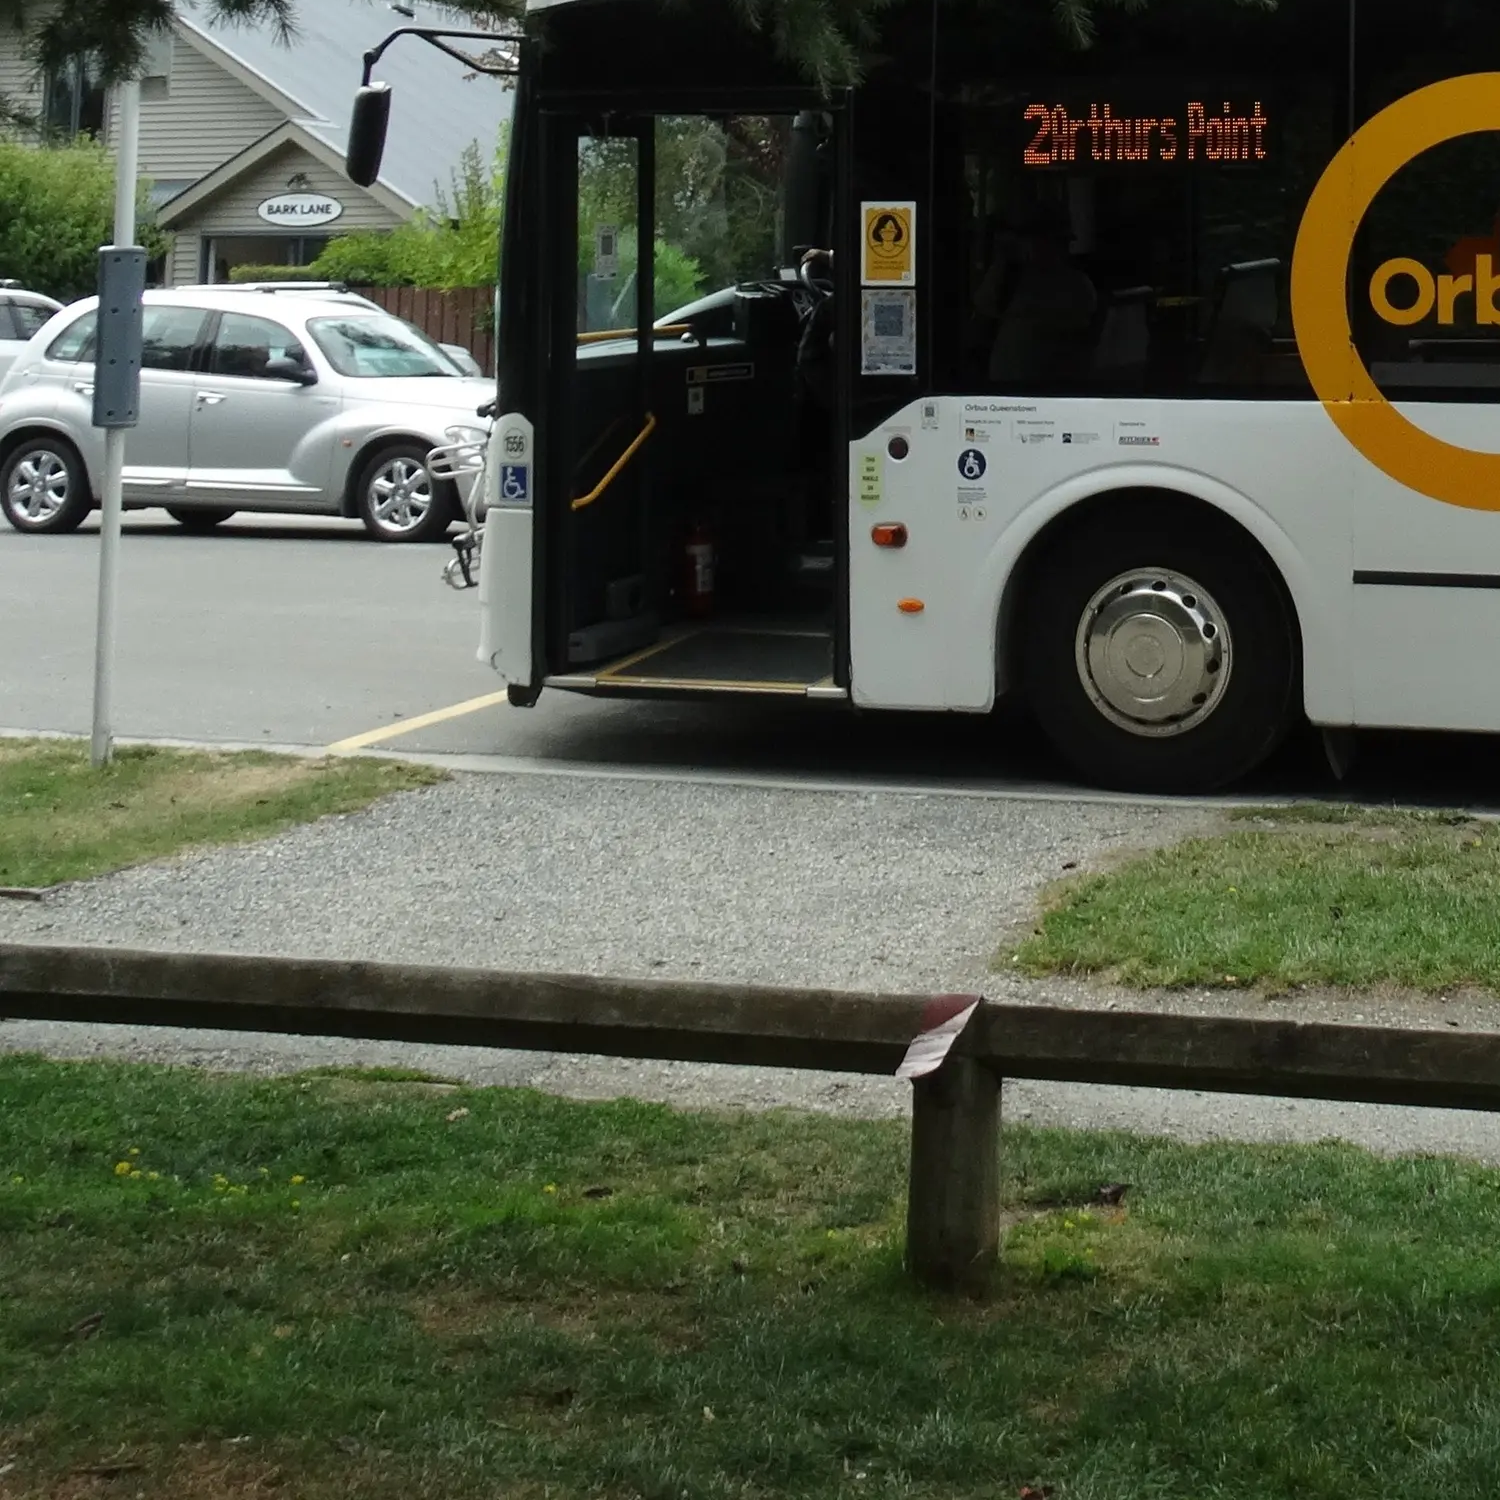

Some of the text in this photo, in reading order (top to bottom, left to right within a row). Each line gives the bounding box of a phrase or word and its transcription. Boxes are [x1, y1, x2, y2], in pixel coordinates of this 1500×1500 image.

[1187, 100, 1267, 161] Point
[267, 203, 332, 215] BARK LANE
